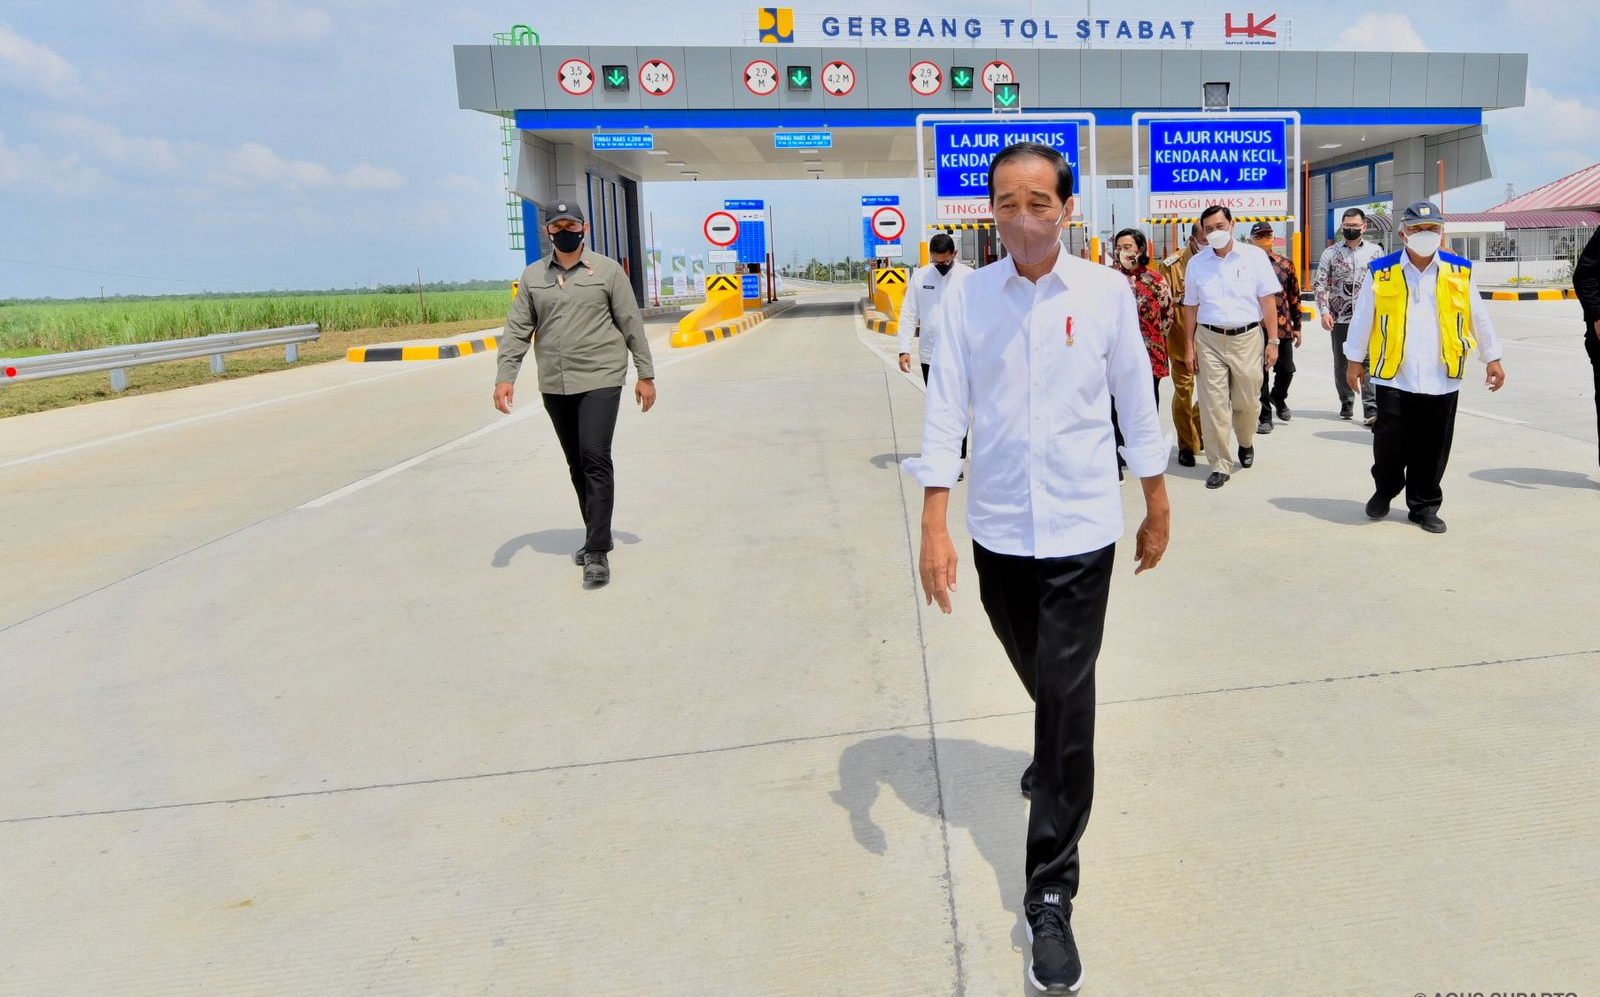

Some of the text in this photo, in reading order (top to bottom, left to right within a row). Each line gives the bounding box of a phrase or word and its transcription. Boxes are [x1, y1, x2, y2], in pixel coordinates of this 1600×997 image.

[821, 17, 1195, 40] GERBANG TOL STABAT
[1225, 13, 1277, 38] HK
[569, 65, 583, 77] 3,5
[755, 67, 768, 78] 2,9
[572, 79, 581, 88] M
[646, 73, 669, 84] 4,2 M
[758, 79, 766, 88] M
[827, 74, 850, 85] 4,2 M
[922, 79, 930, 88] M
[987, 73, 1009, 84] 4,2 M
[951, 133, 1065, 148] LAJUR KHUSUS
[1164, 130, 1273, 145] LAJUR KHUSUS
[941, 153, 997, 167] KENDA
[1155, 149, 1282, 164] KENDARAAN KECIL,
[960, 172, 988, 187] SED
[1237, 167, 1267, 182] JEEP
[944, 204, 993, 214] TINGGI
[1157, 199, 1201, 209] TINGGI
[1205, 198, 1243, 208] MAKS
[1247, 197, 1265, 207] 2.1
[1043, 893, 1060, 903] NAH
